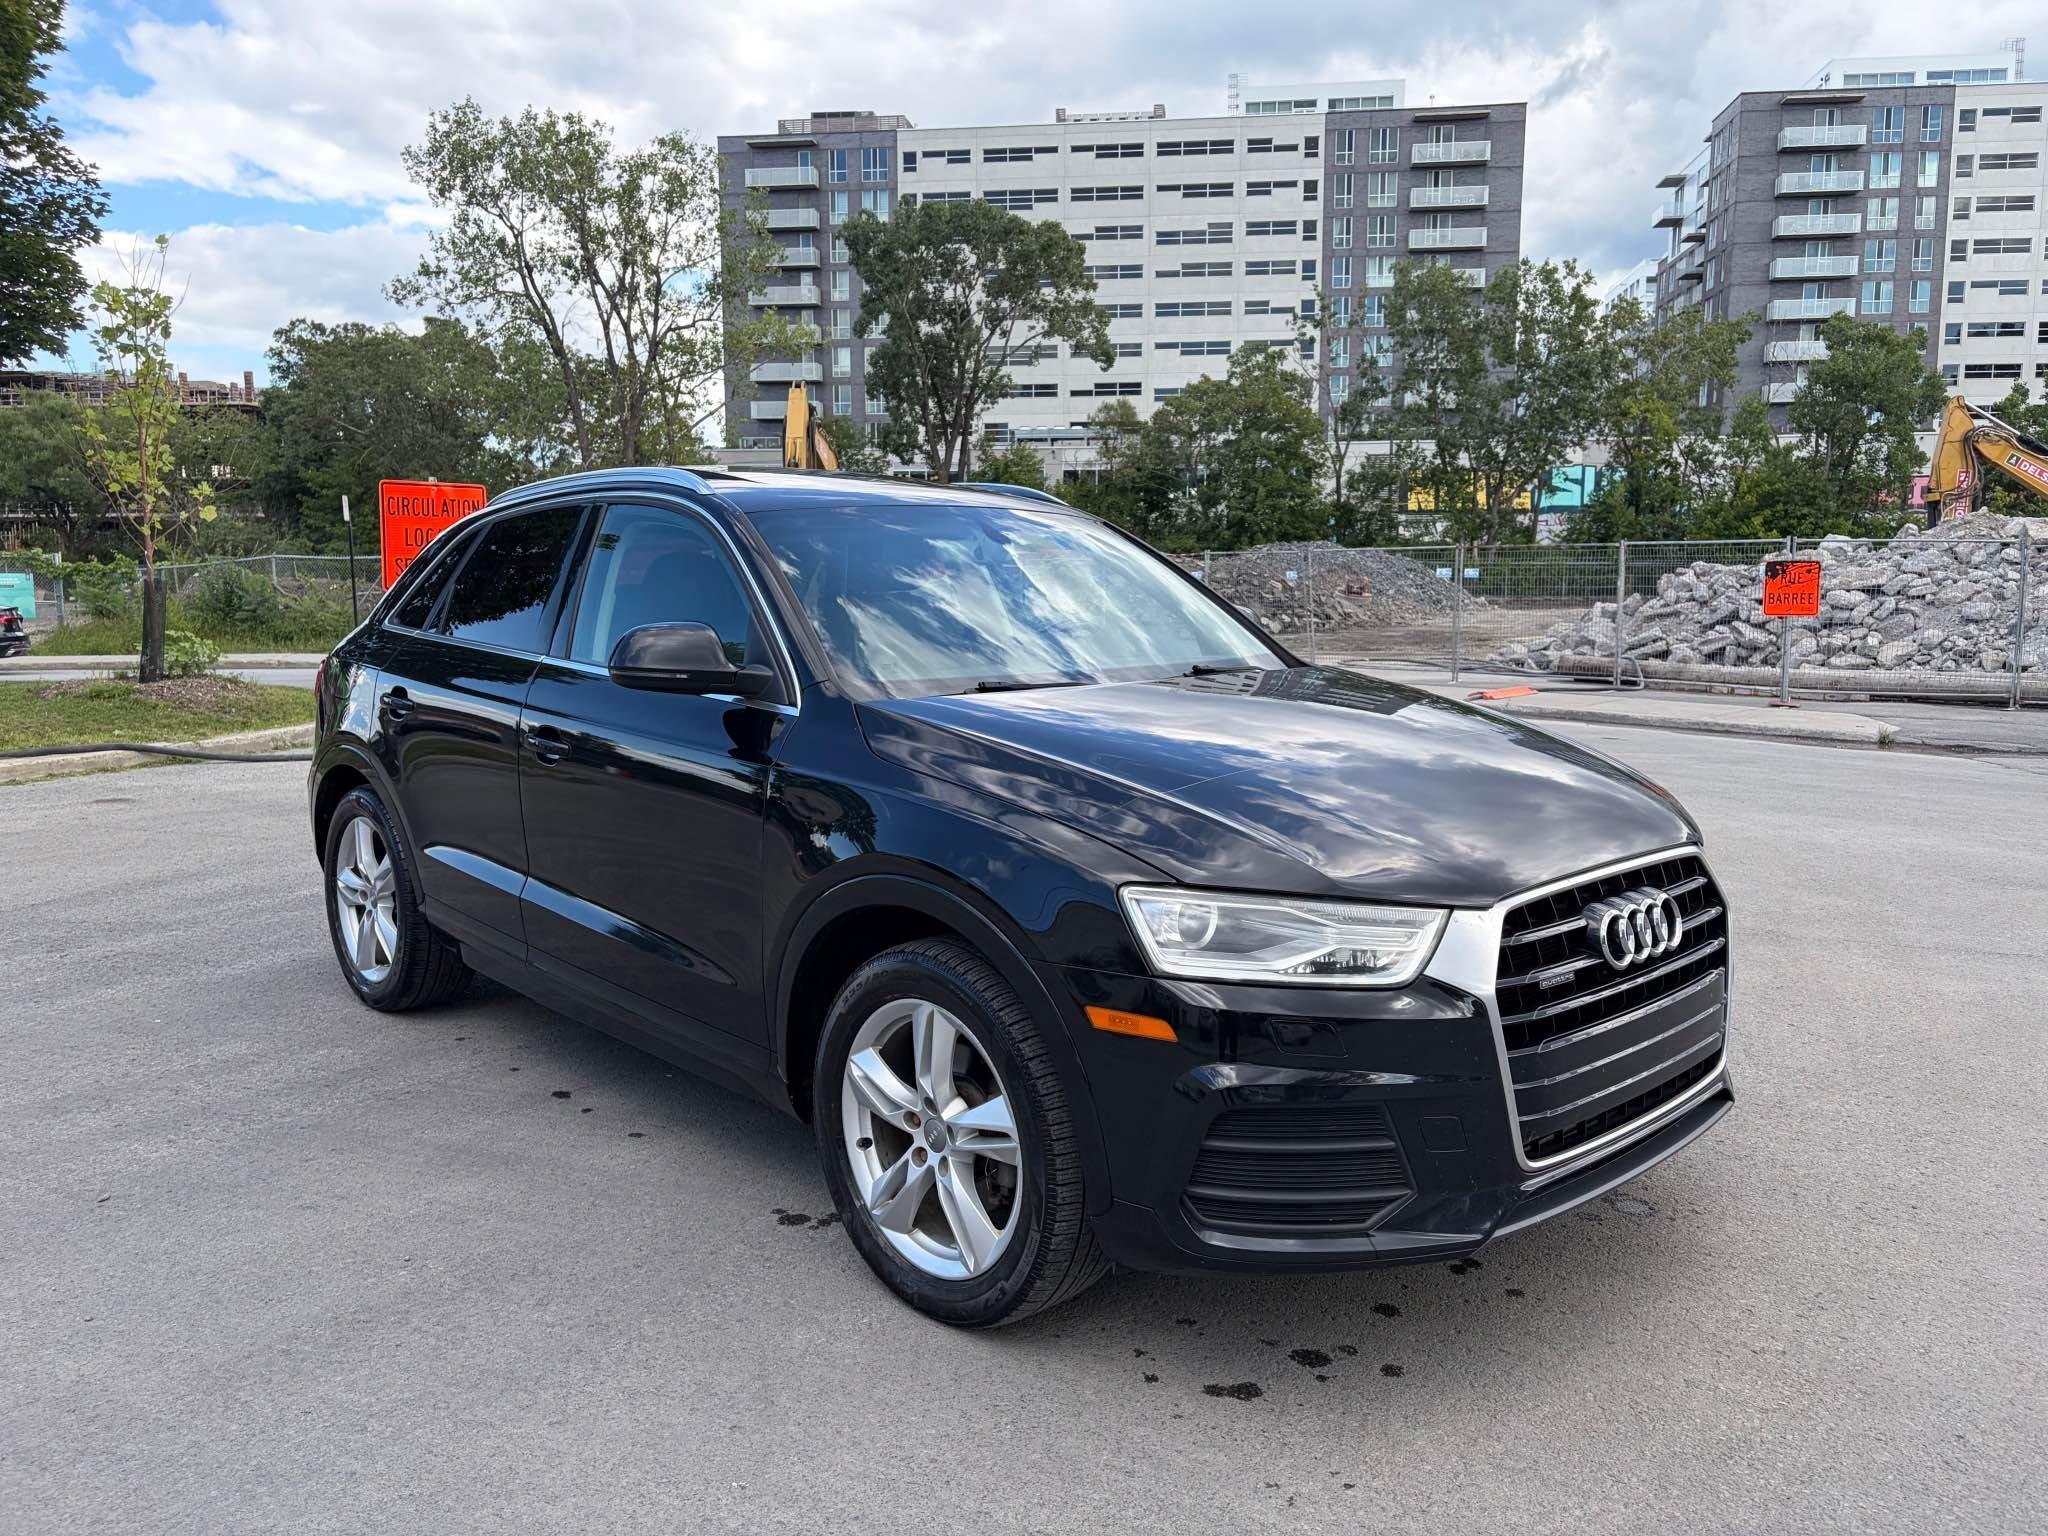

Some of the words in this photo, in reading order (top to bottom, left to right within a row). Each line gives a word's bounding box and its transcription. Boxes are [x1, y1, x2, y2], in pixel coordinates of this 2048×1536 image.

[2020, 460, 2048, 484] DELS
[387, 496, 480, 516] CIRCULATION
[405, 527, 443, 547] LOC
